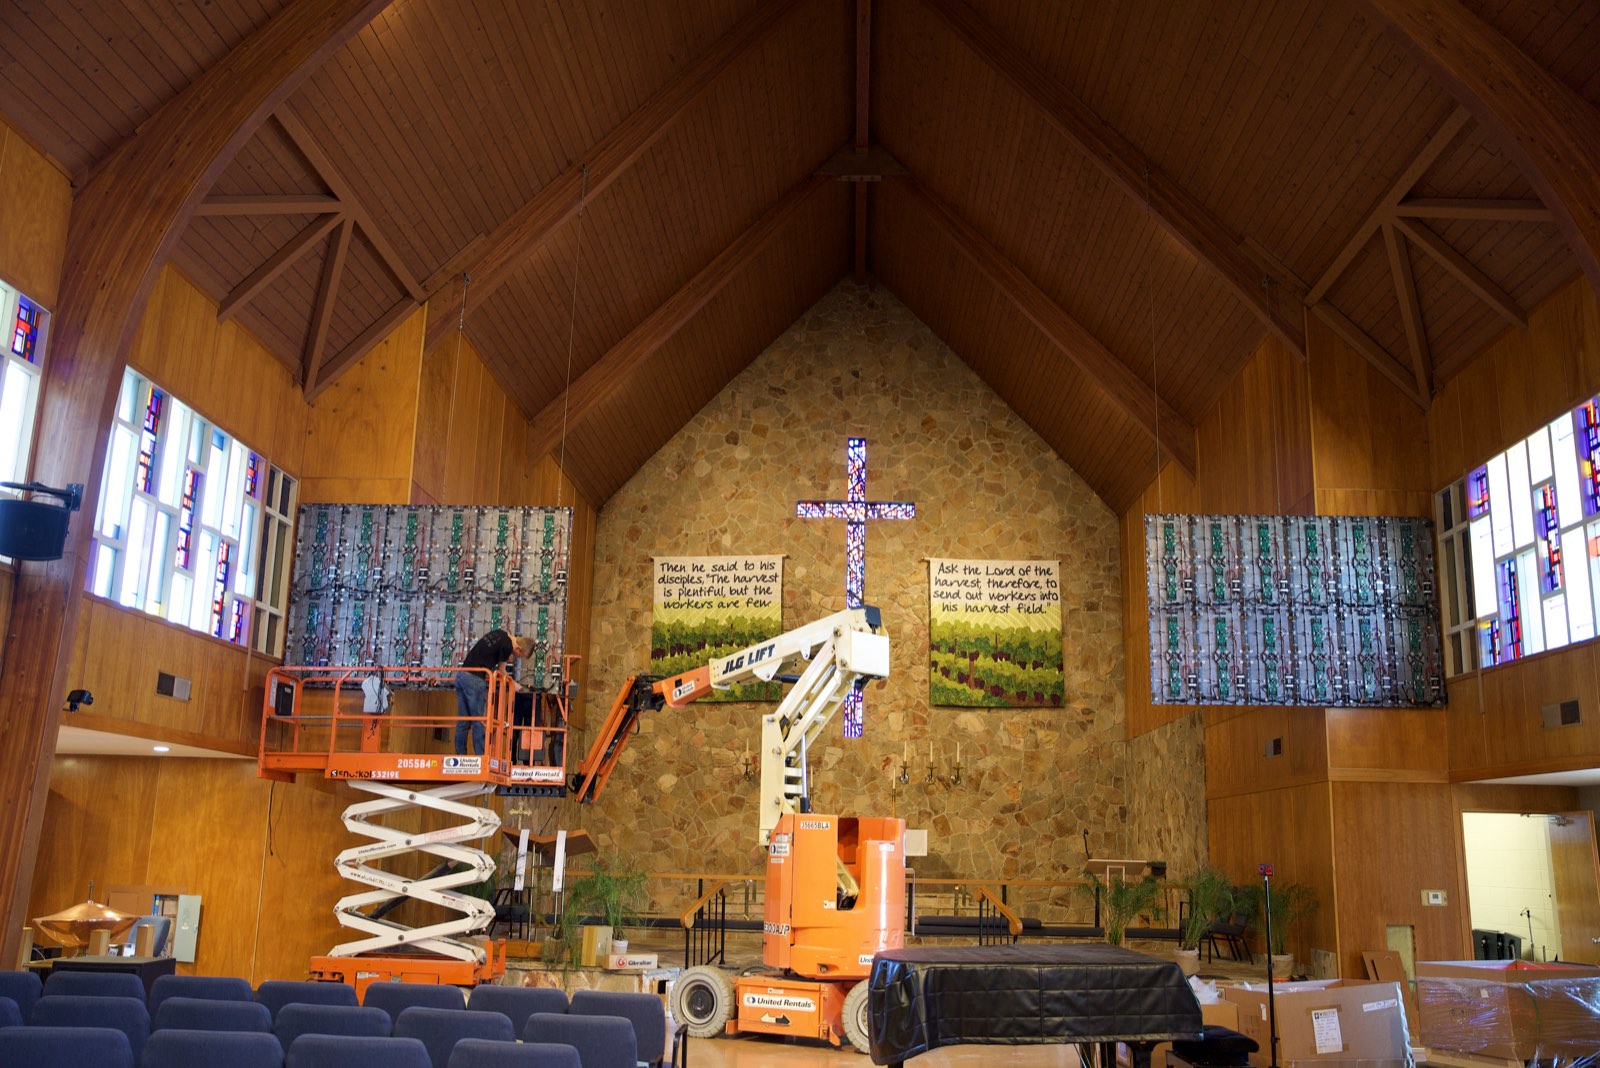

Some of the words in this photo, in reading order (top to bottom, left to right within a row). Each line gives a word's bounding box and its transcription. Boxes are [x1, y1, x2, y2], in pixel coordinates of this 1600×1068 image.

[660, 562, 686, 573] Then
[691, 563, 706, 572] he
[711, 561, 738, 572] said
[744, 561, 755, 571] to
[760, 561, 776, 571] his
[938, 562, 958, 575] Ask
[963, 565, 982, 575] the
[985, 565, 1015, 577] Lord
[1018, 565, 1032, 577] of
[1034, 566, 1053, 577] the
[657, 574, 705, 588] disciples,
[706, 573, 730, 584] "The
[733, 573, 779, 583] harvest
[934, 576, 982, 589] harvest,
[987, 580, 1042, 589] therefore,
[1046, 579, 1058, 588] to
[663, 588, 673, 597] is
[678, 586, 726, 600] plentiful,
[729, 585, 748, 596] but
[754, 585, 773, 595] the
[932, 589, 962, 600] send
[965, 589, 983, 601] out
[988, 590, 1037, 601] workers
[1040, 592, 1059, 601] into
[663, 599, 713, 609] workers
[717, 601, 740, 609] are
[746, 597, 772, 607] few
[942, 602, 958, 612] his
[965, 603, 1010, 613] harvest
[1017, 602, 1051, 614] field."
[722, 655, 744, 675] JLG
[748, 643, 775, 665] LIFT
[397, 758, 431, 769] 205584
[757, 997, 782, 1006] United
[783, 999, 812, 1008] Rentals
